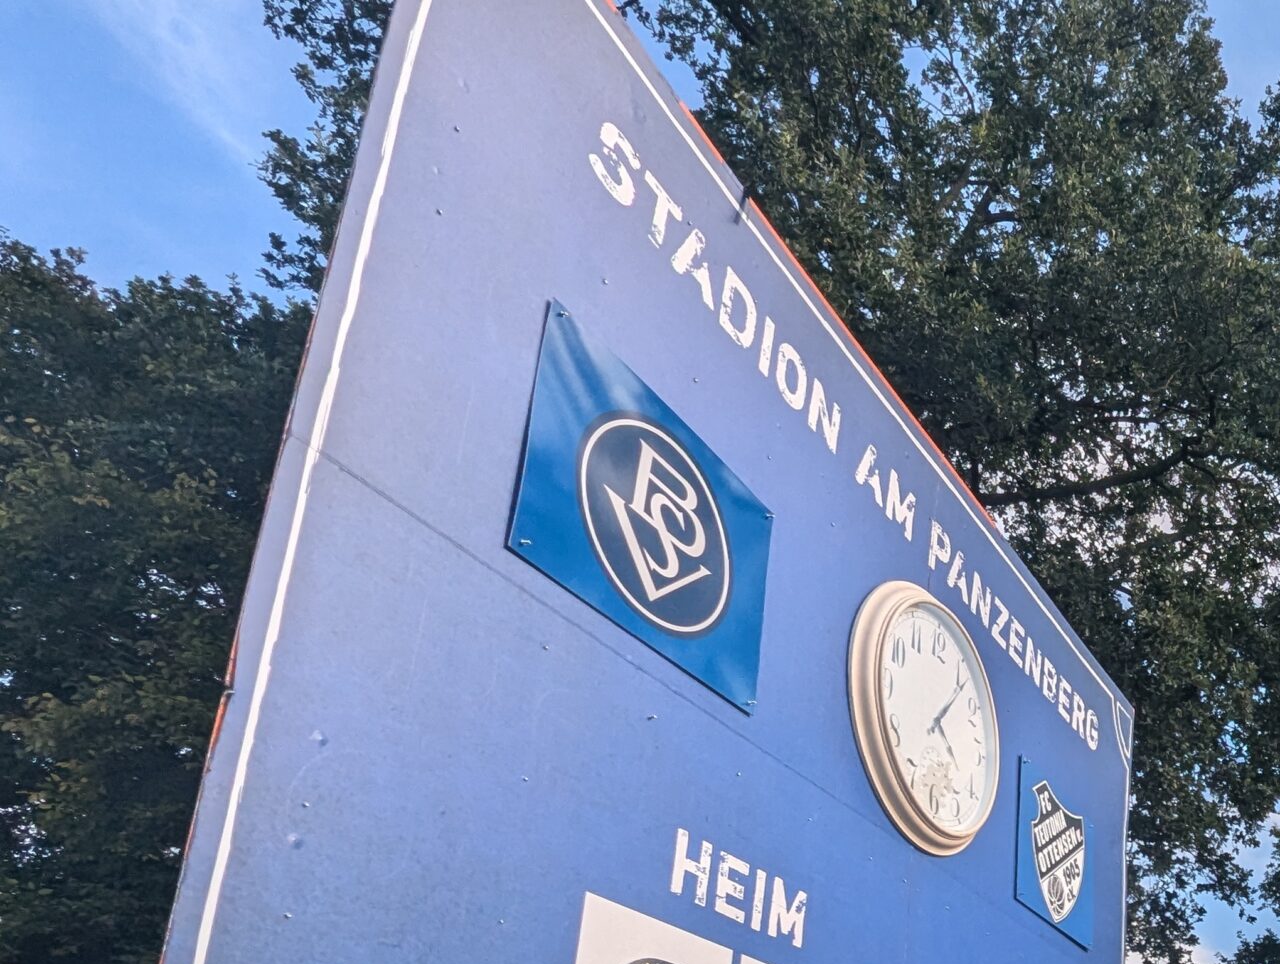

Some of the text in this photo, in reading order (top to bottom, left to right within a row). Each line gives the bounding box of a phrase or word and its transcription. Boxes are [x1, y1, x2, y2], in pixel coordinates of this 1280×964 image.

[589, 122, 1100, 751] STADION AM PANZENBERG
[890, 631, 906, 669] 10
[910, 619, 922, 655] 11
[930, 622, 947, 665] 12
[883, 666, 894, 701] 9
[889, 712, 901, 748] 8
[967, 696, 979, 729] 2
[906, 757, 918, 790] 7
[966, 771, 979, 801] 4
[928, 783, 940, 818] 6
[950, 786, 961, 818] 5
[1039, 791, 1052, 814] FC
[1033, 809, 1067, 848] TEUTONIA
[1037, 826, 1077, 873] OTTENSEN
[669, 827, 808, 947] HEIM
[1062, 858, 1080, 888] 1905
